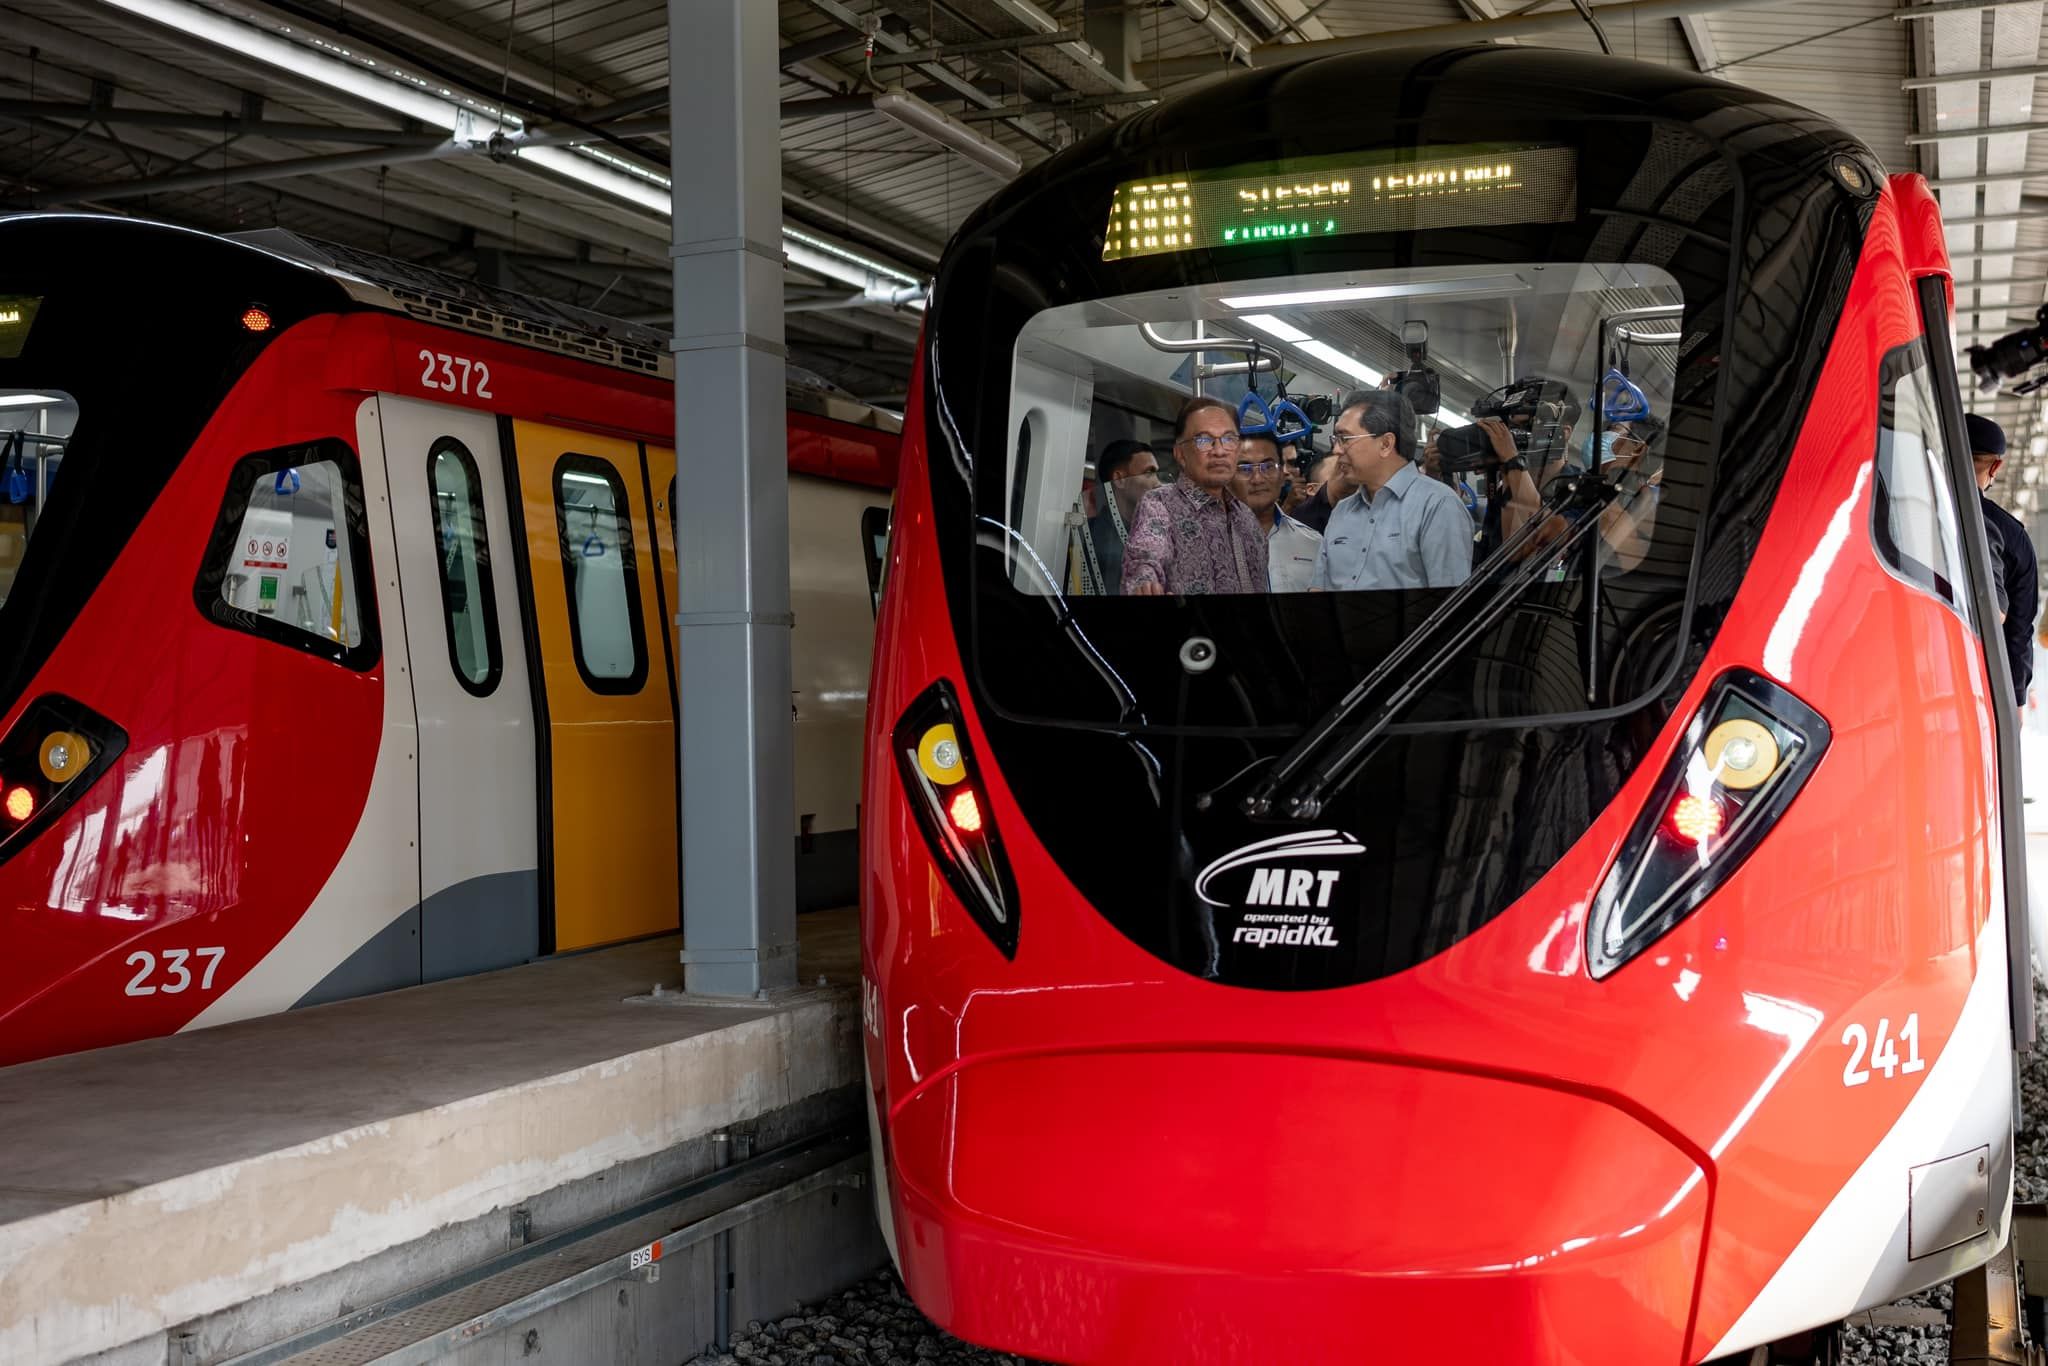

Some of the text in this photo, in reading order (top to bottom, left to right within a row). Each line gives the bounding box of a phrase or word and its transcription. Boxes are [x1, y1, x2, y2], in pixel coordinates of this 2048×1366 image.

[419, 349, 493, 399] 2372
[1245, 868, 1340, 907] MRT
[1232, 925, 1339, 949] rapidKL
[1243, 913, 1330, 926] operated by
[124, 946, 226, 996] 237
[1841, 1012, 1925, 1087] 241
[633, 1248, 650, 1266] SYS
